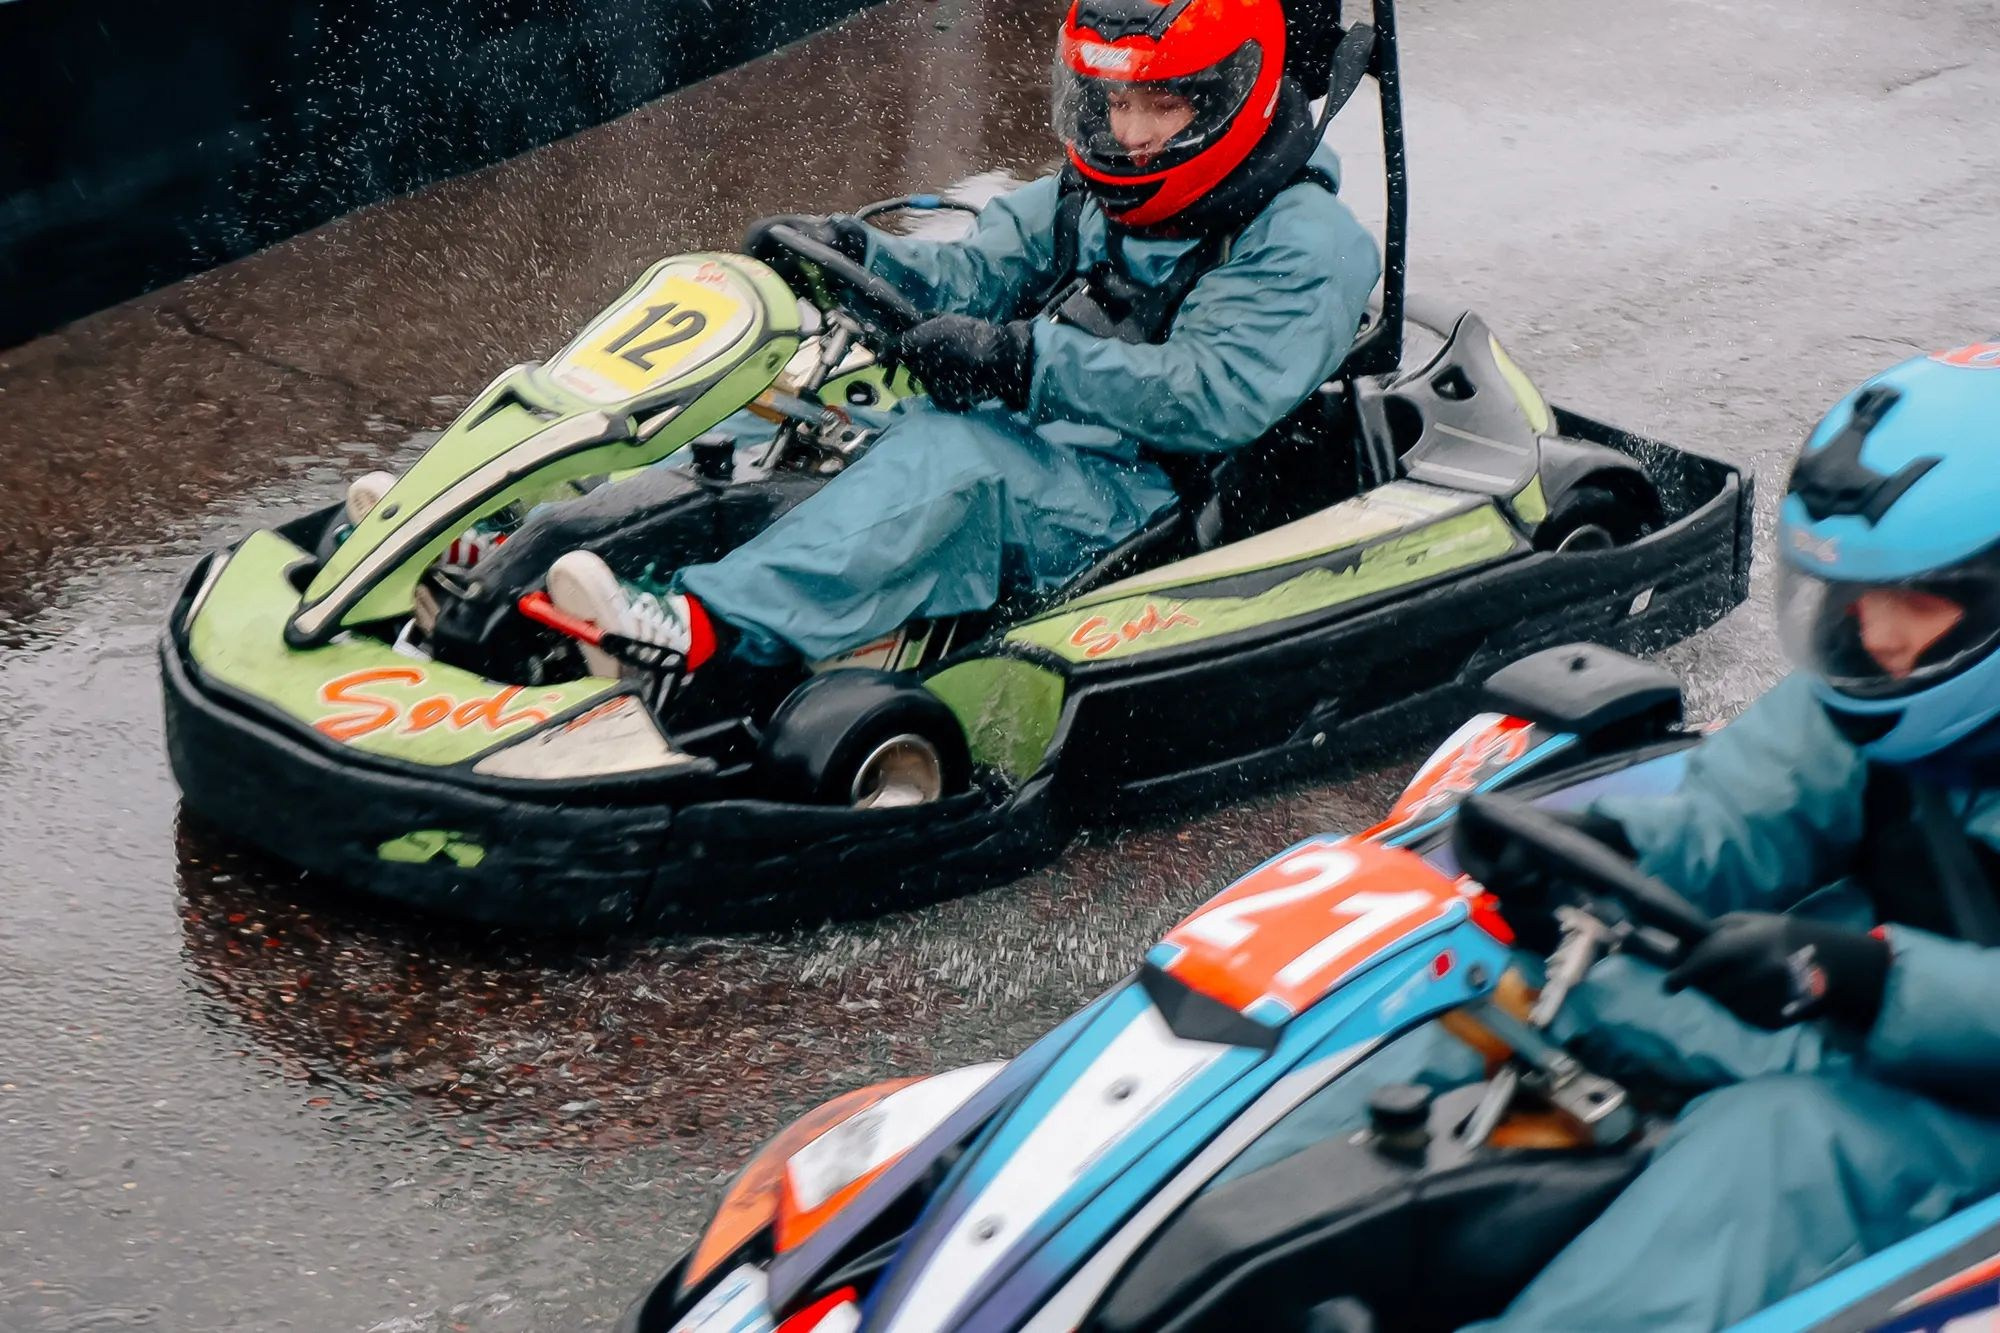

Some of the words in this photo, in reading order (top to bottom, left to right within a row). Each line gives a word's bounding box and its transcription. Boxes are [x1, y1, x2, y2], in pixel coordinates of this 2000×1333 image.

[603, 301, 707, 372] 12
[313, 667, 564, 743] Sodi
[1180, 851, 1434, 987] 21
